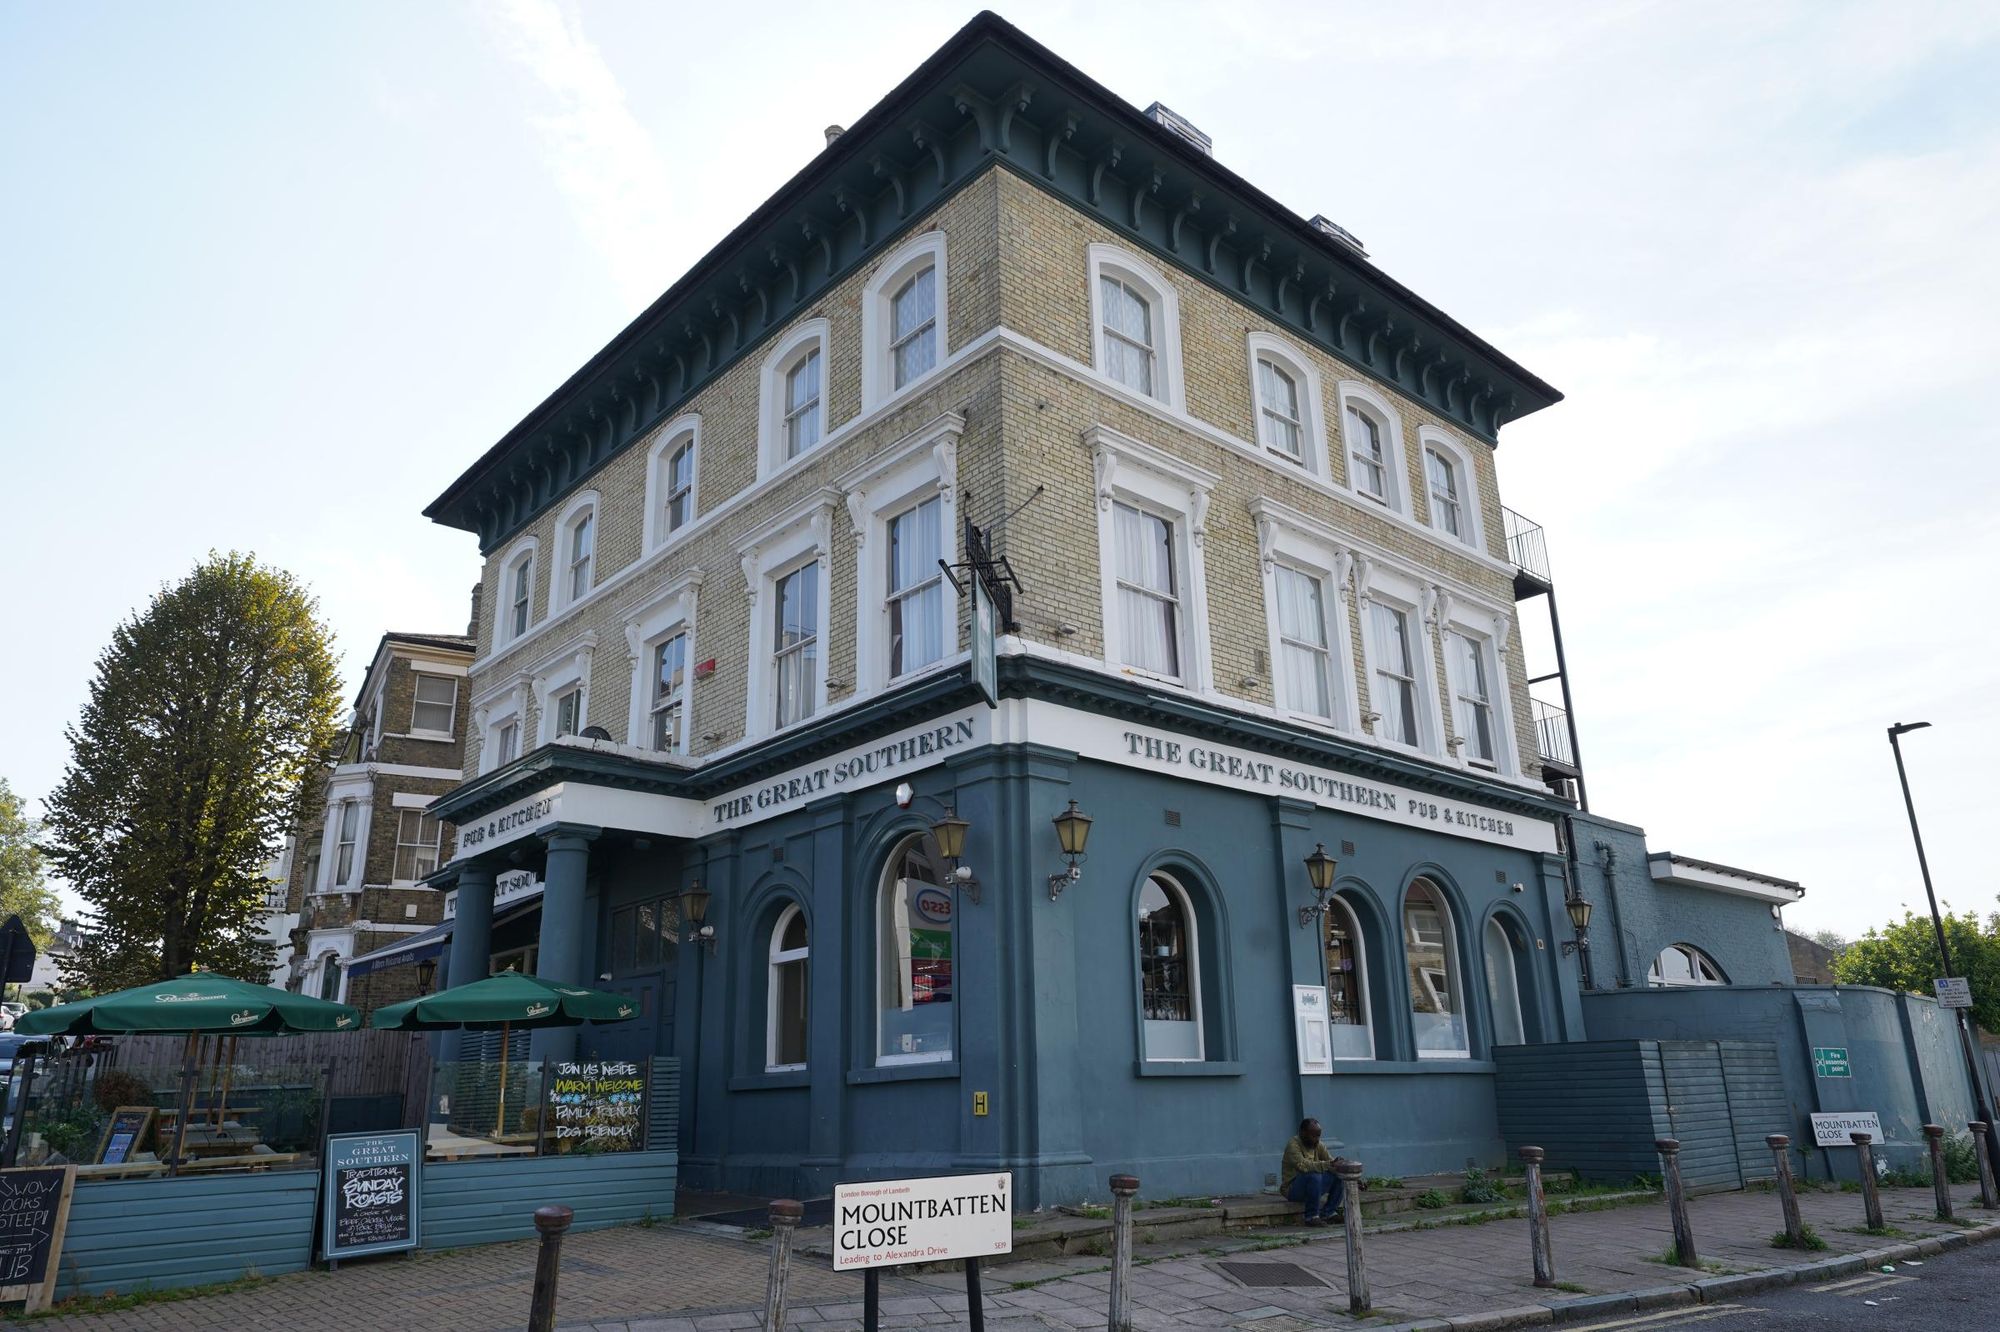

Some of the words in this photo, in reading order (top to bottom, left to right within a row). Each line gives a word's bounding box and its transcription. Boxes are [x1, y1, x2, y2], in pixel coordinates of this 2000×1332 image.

[713, 795, 753, 823] THE
[757, 768, 830, 809] GREAT
[834, 717, 974, 784] SOUTHERN
[1123, 731, 1182, 764] THE
[1188, 747, 1274, 784] GREAT
[1279, 768, 1397, 811] SOUTHERN
[1408, 799, 1438, 820] PUB
[1444, 808, 1454, 824] &
[1456, 810, 1514, 836] KITCHEN
[463, 826, 485, 848] PUB
[488, 822, 496, 838] &
[498, 798, 552, 833] KITCHEN
[557, 1062, 580, 1075] JOIN
[583, 1063, 599, 1075] US
[600, 1061, 637, 1076] INSIDE
[556, 1079, 591, 1094] WARM
[595, 1080, 644, 1093] WELCOME
[975, 1094, 985, 1113] H
[556, 1105, 593, 1121] FAMILY
[556, 1125, 582, 1138] DOG
[585, 1124, 634, 1137] FRIENDLY
[1814, 1120, 1879, 1129] MOUNTBATTEN
[1817, 1130, 1843, 1139] CLOSE
[352, 1146, 396, 1156] GREAT
[337, 1153, 409, 1166] SOUTHERN
[342, 1167, 403, 1180] TRADITIONAL
[14, 1178, 59, 1196] WOW
[343, 1177, 405, 1194] SUNDAY
[841, 1190, 860, 1198] London
[860, 1189, 882, 1198] Borough
[888, 1186, 911, 1195] Lambeth
[345, 1190, 404, 1209] ROASTS
[841, 1193, 1007, 1226] MOUNTBATTEN
[840, 1225, 908, 1251] CLOSE
[994, 1241, 1007, 1250] SE19
[840, 1254, 870, 1265] Leading
[873, 1253, 882, 1261] to
[885, 1248, 925, 1260] Alexandra
[927, 1246, 948, 1256] Drive
[0, 1254, 33, 1280] UB
